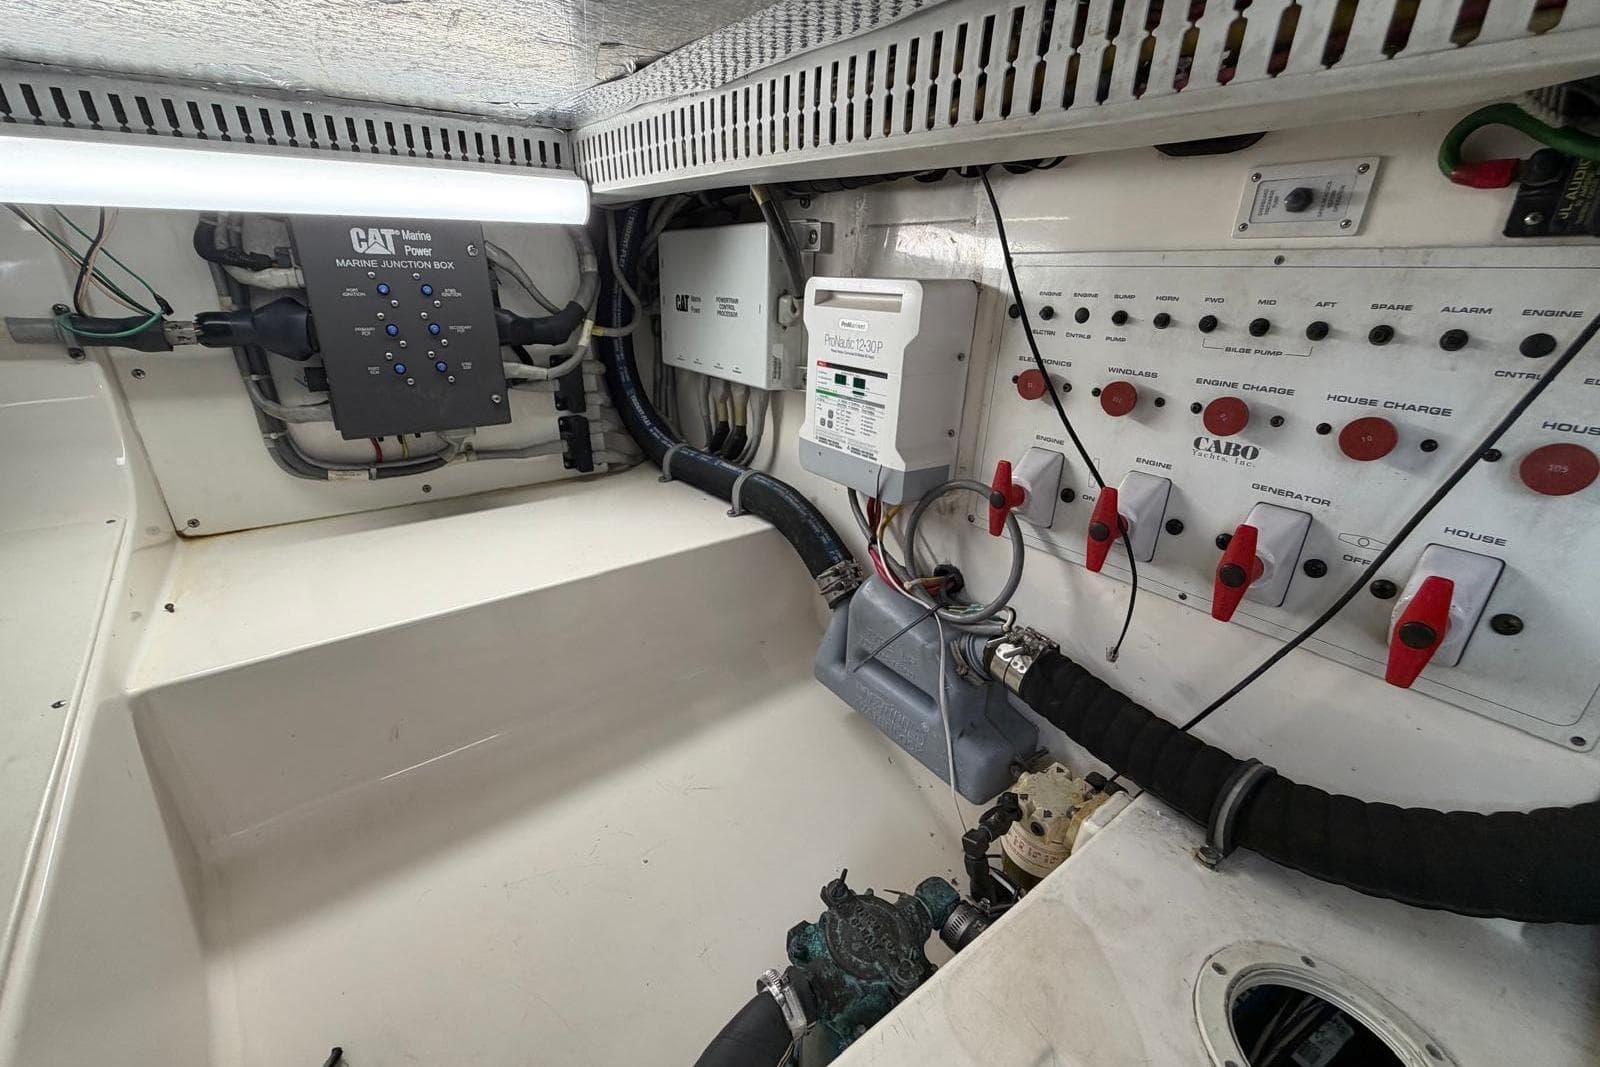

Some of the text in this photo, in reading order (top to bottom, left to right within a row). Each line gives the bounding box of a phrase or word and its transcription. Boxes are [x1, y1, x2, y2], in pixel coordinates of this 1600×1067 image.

[349, 227, 397, 255] CAT
[401, 229, 432, 242] Marine
[404, 245, 433, 257] Power
[335, 259, 455, 270] MARINE JUNCTION BOX
[675, 294, 690, 312] CAT
[1257, 298, 1277, 306] MID
[1370, 303, 1414, 311] SPARE
[1440, 306, 1493, 315] ALARM
[1521, 309, 1585, 318] ENGINE
[1224, 346, 1283, 357] BILGE PUMP
[1018, 355, 1073, 367] ELECRONICS
[1107, 366, 1159, 379] WINDLASS
[1195, 377, 1295, 396] ENGINE CHARGE
[1327, 393, 1453, 417] HOUSE CHARGE
[1035, 434, 1065, 446] ENGINE
[1192, 436, 1260, 461] CABO
[1135, 457, 1173, 470] ENGINE
[1191, 448, 1257, 468] Yachts, Inc.
[1082, 494, 1096, 503] ON
[1251, 482, 1332, 507] GENERATOR
[1443, 526, 1508, 547] HOUSE
[1342, 554, 1371, 565] OFF
